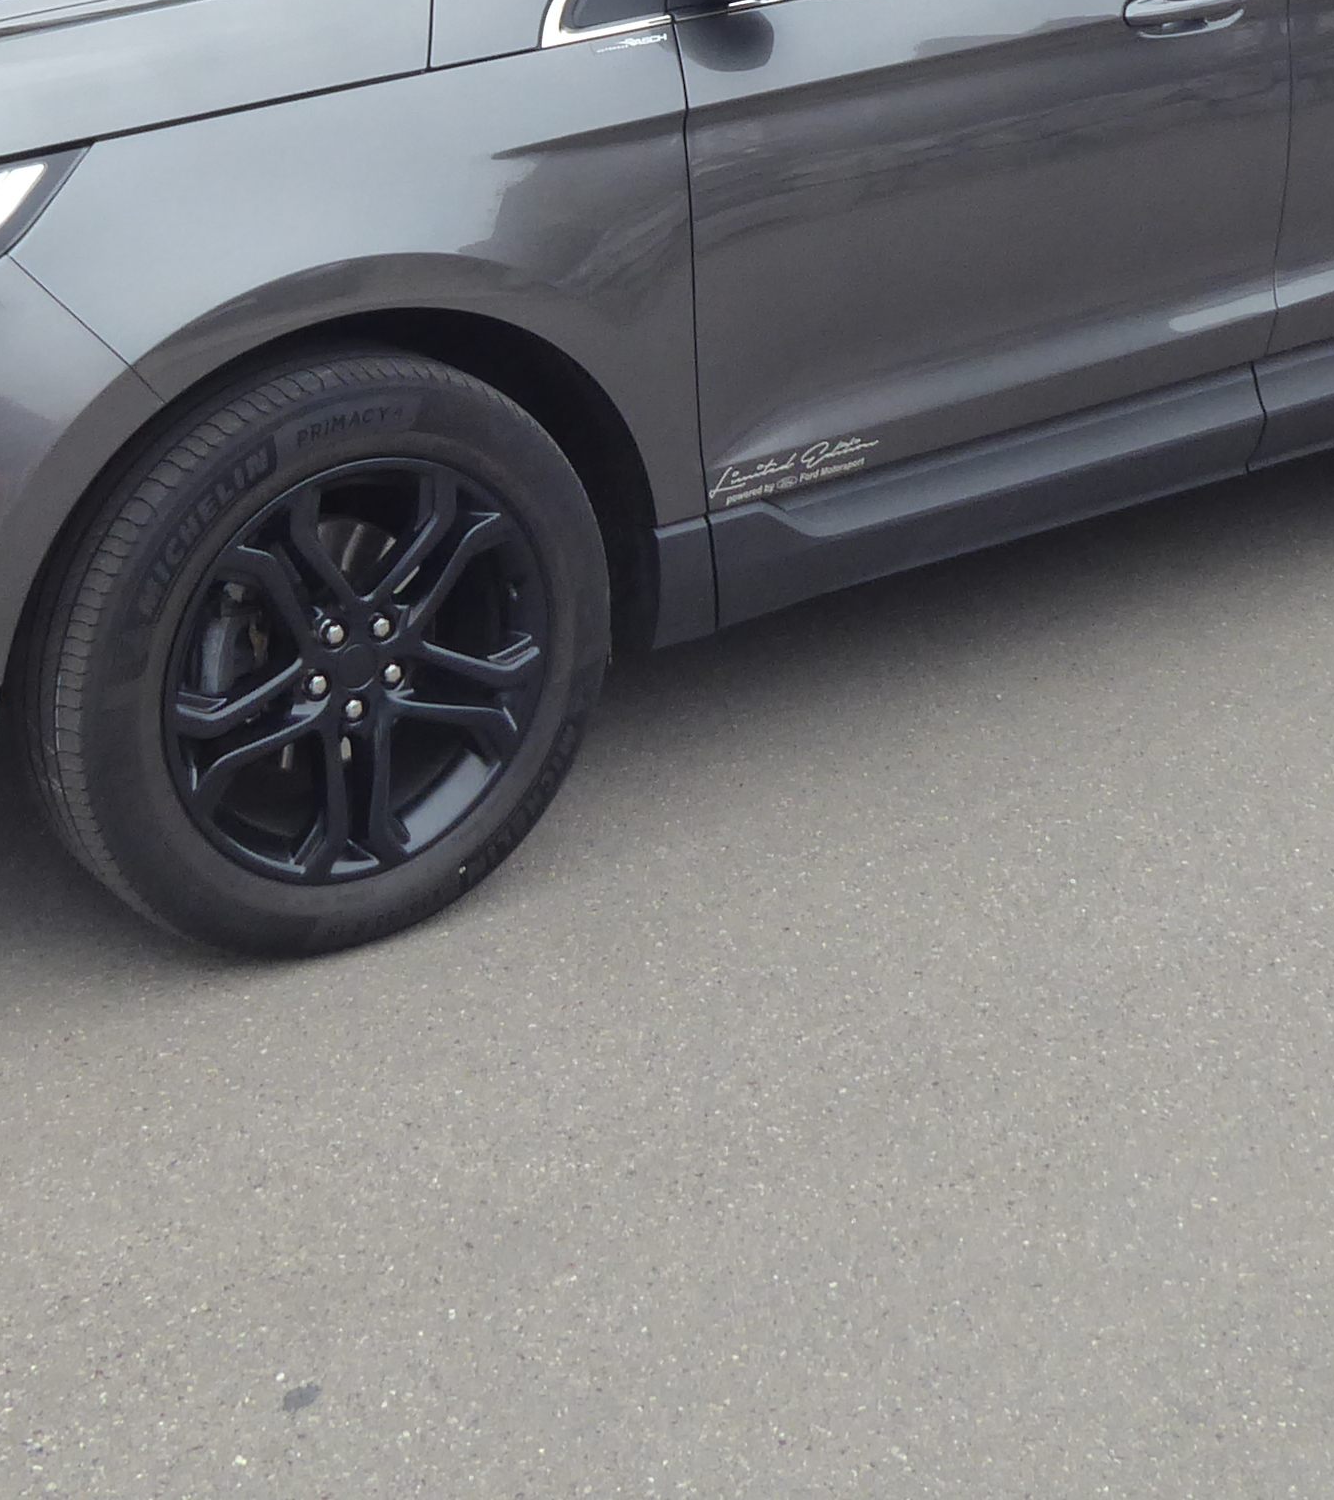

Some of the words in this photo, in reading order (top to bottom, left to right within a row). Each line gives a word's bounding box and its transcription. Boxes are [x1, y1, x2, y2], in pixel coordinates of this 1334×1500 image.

[296, 408, 388, 447] PRIMACY
[709, 452, 797, 499] Limited
[800, 437, 879, 469] Edition
[725, 485, 763, 506] powered
[800, 468, 819, 483] Ford
[820, 457, 866, 480] Motorsport
[137, 445, 271, 616] MICHELIN
